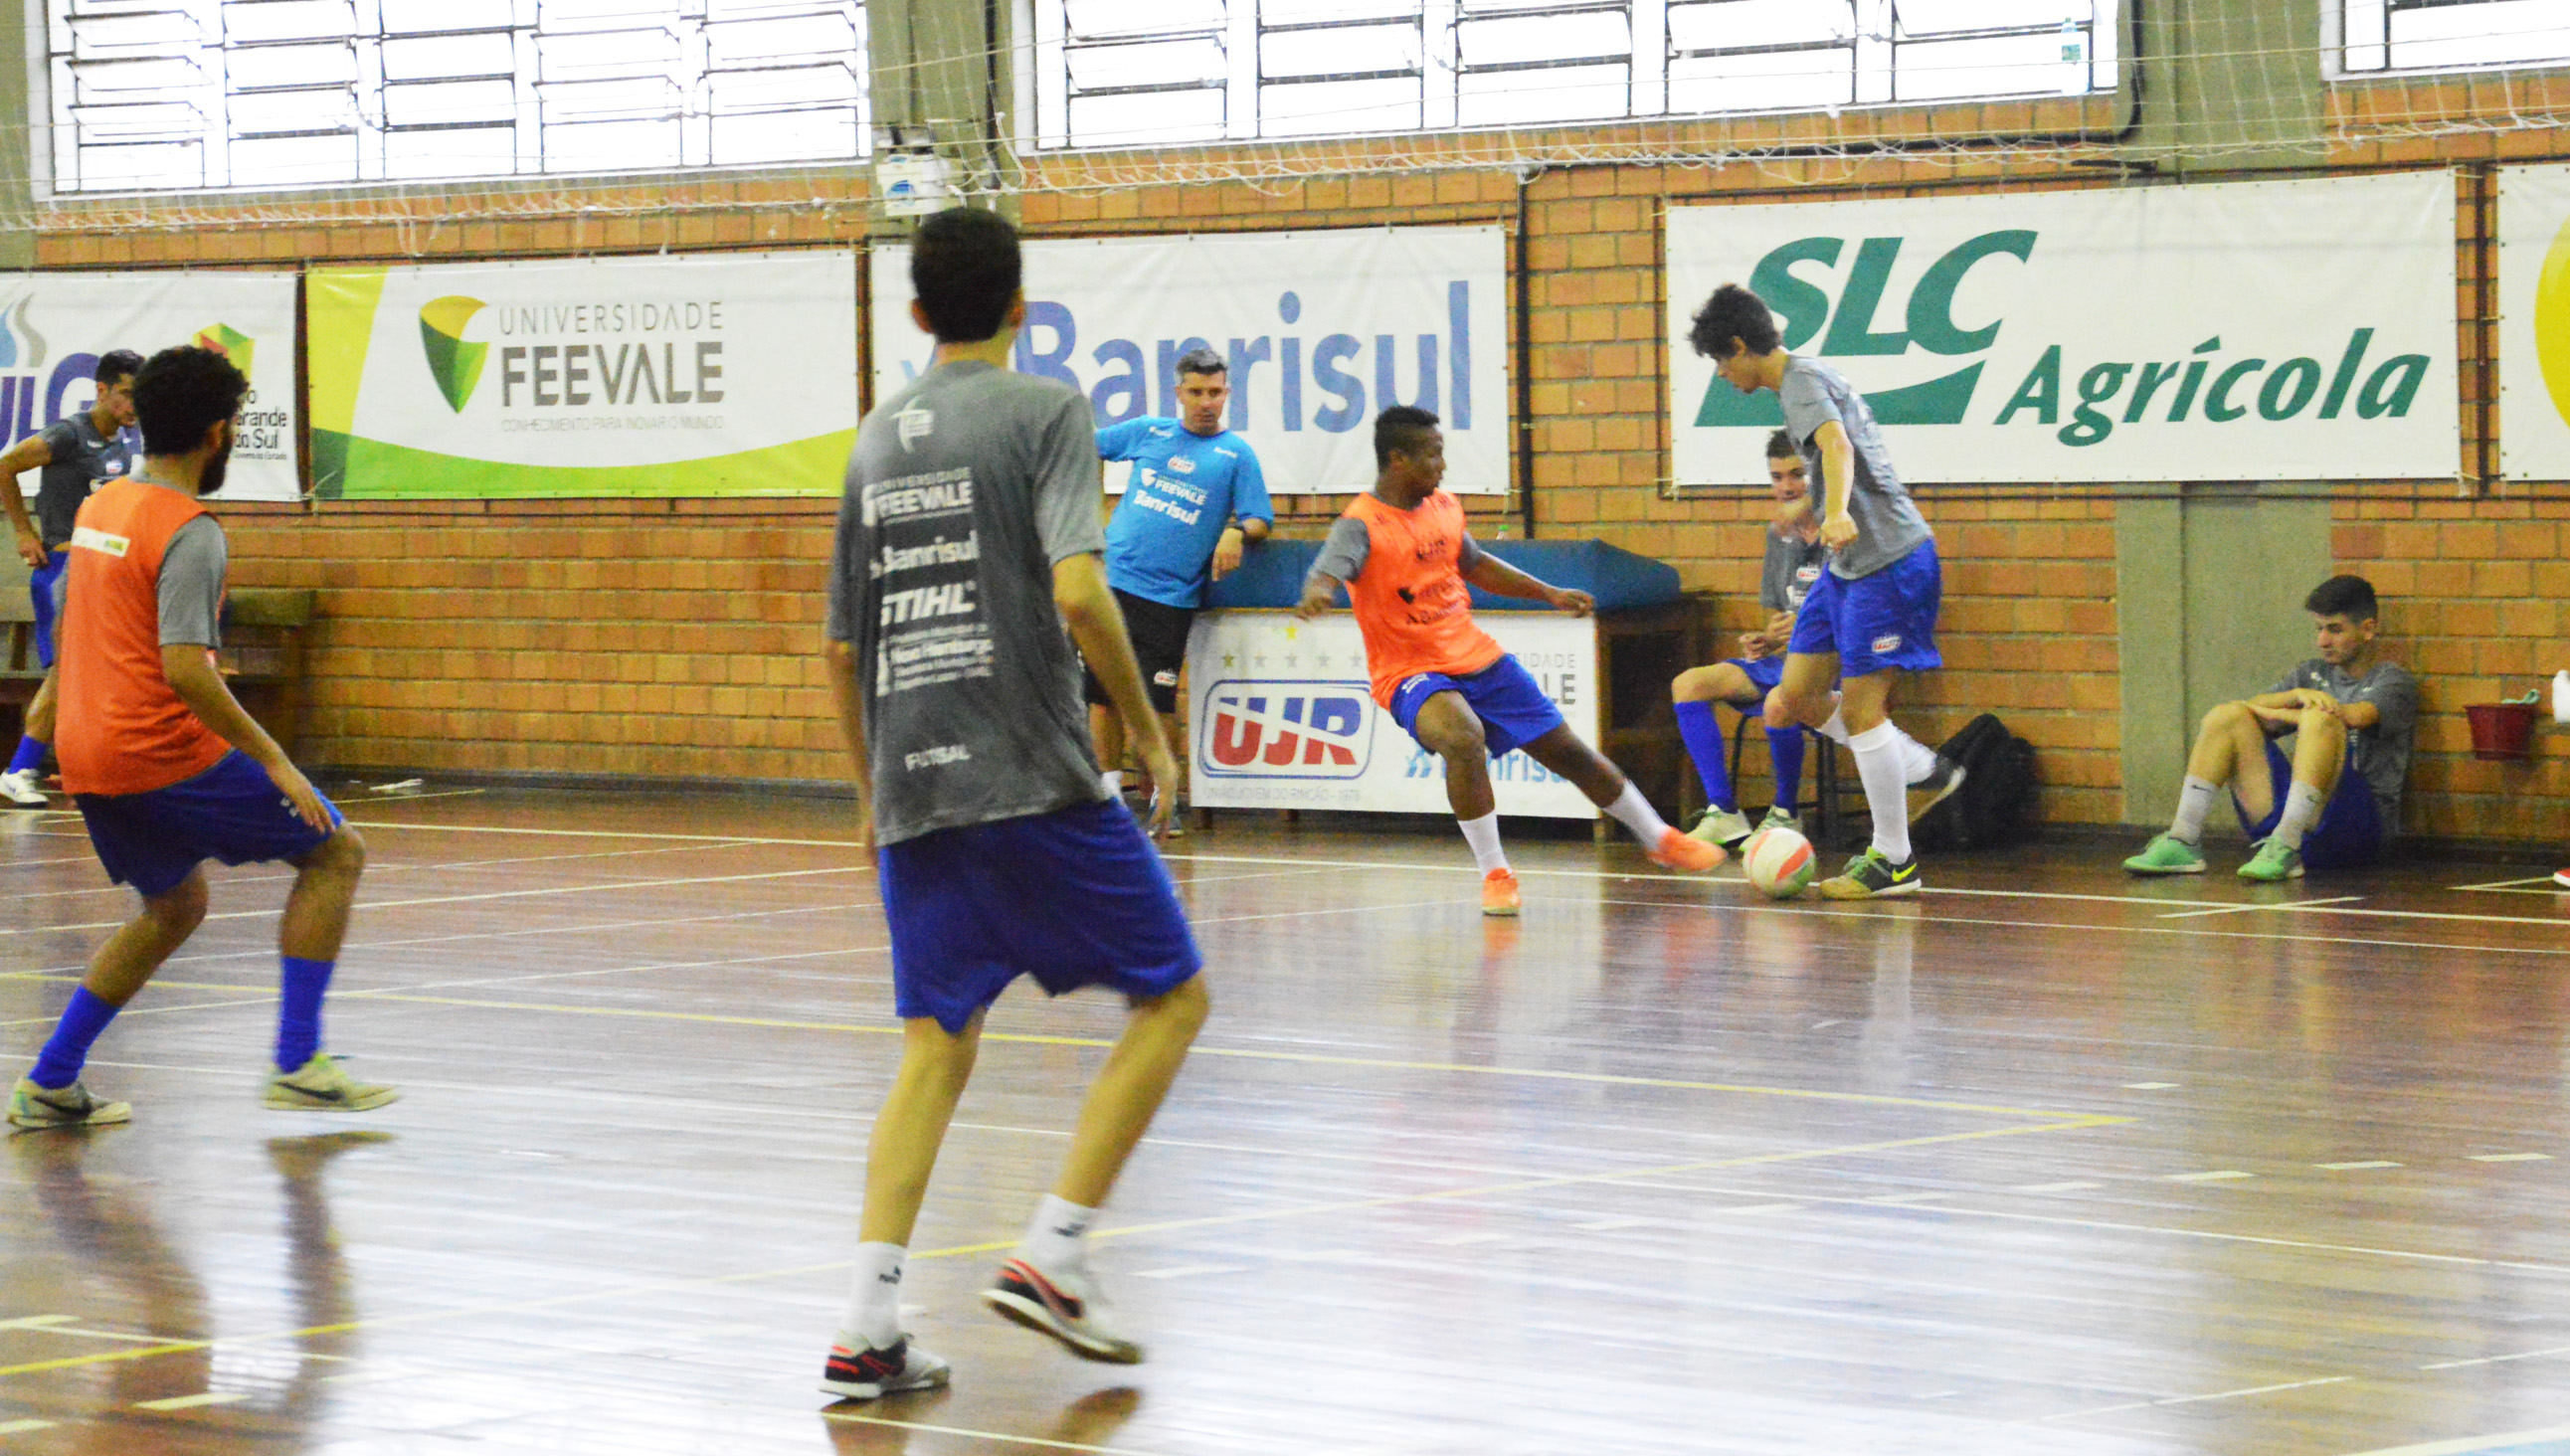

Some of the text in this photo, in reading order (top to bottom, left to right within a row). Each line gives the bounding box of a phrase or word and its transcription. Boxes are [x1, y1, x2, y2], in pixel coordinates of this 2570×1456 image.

[499, 301, 723, 335] UNIVERSIDADE
[1748, 229, 2039, 356] SLC
[501, 341, 725, 407] FEEVALE
[1015, 280, 1471, 435] Banrisul
[1993, 327, 2431, 447] Agrícola
[253, 428, 278, 449] Sul
[1134, 489, 1202, 525] Banrisul
[1211, 695, 1363, 767] UJR
